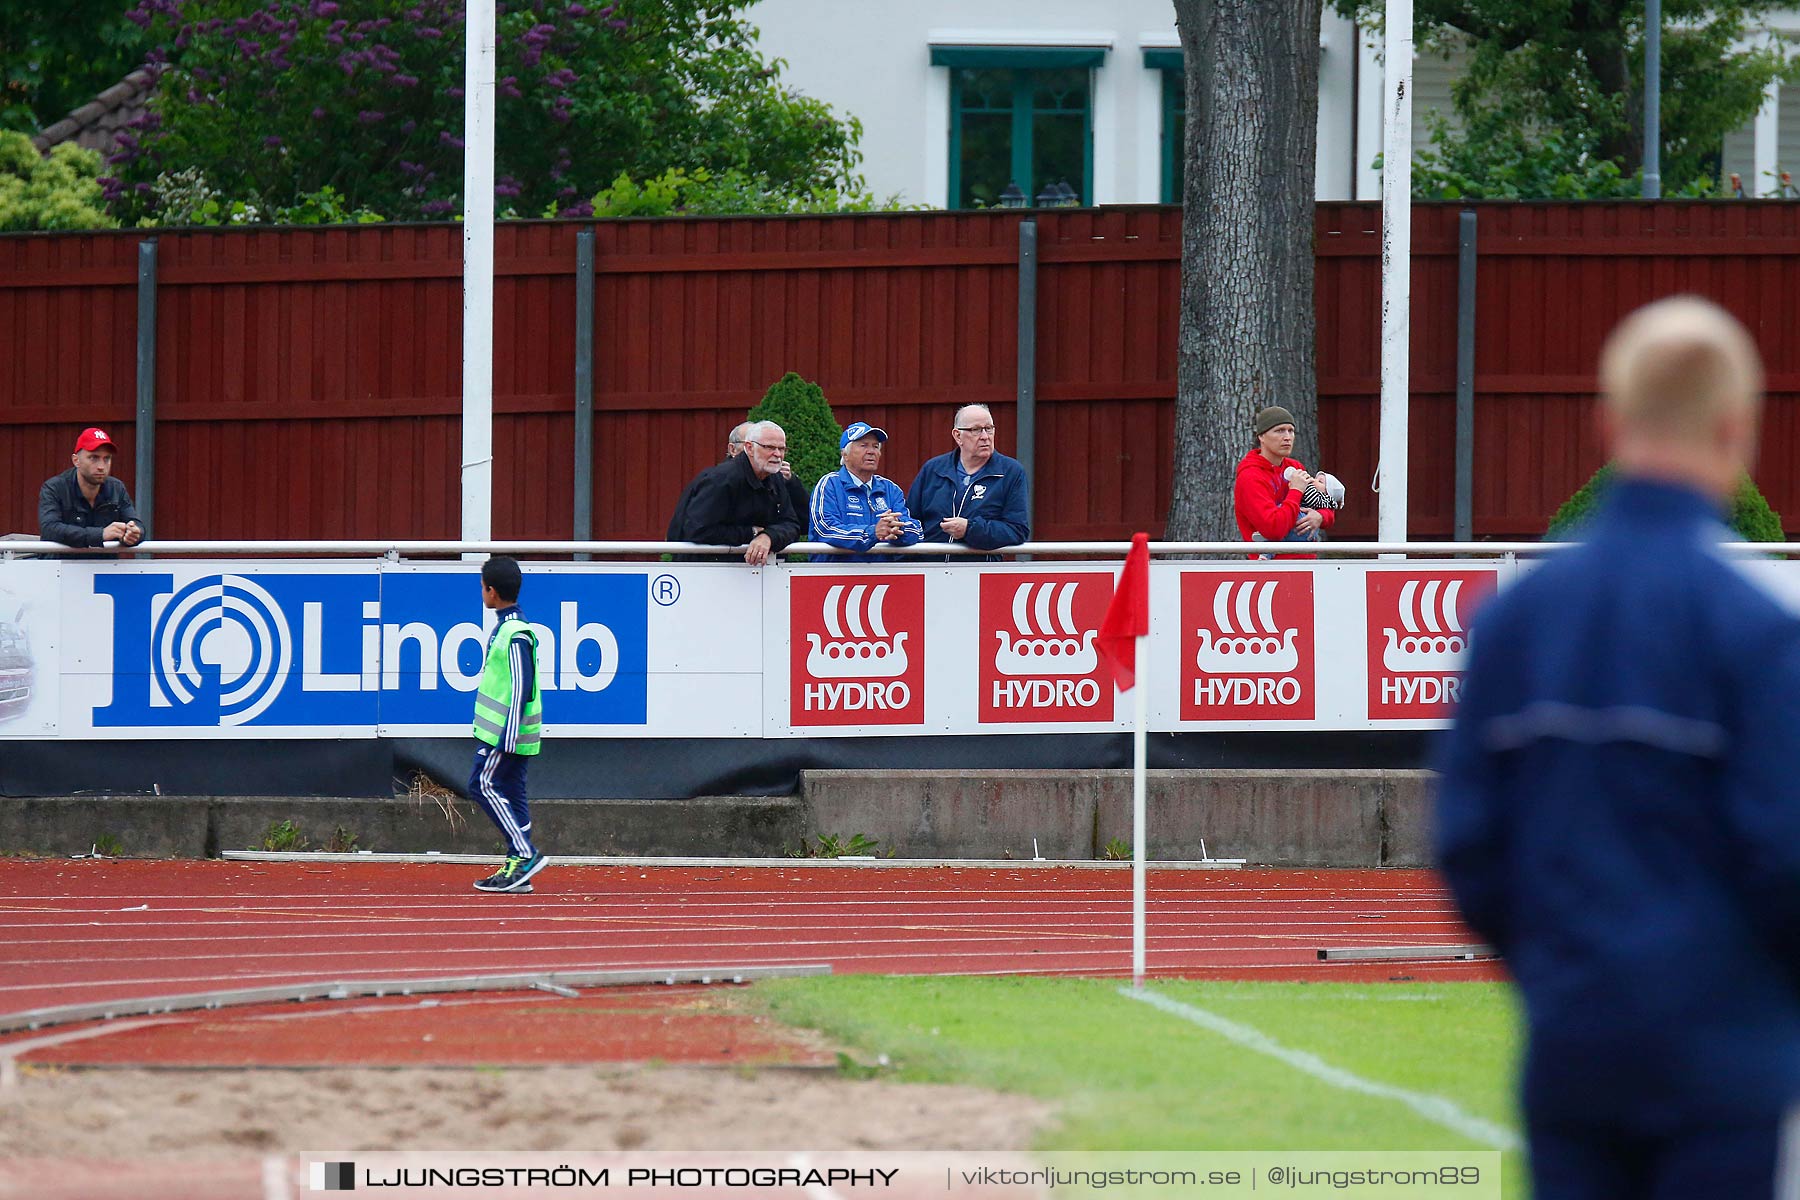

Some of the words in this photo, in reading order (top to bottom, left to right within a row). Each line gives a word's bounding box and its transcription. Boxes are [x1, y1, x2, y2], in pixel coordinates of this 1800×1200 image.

[804, 681, 911, 711] HYDRO
[992, 678, 1101, 708] HYDRO
[1193, 675, 1301, 706] HYDRO
[1381, 676, 1466, 705] HYDR
